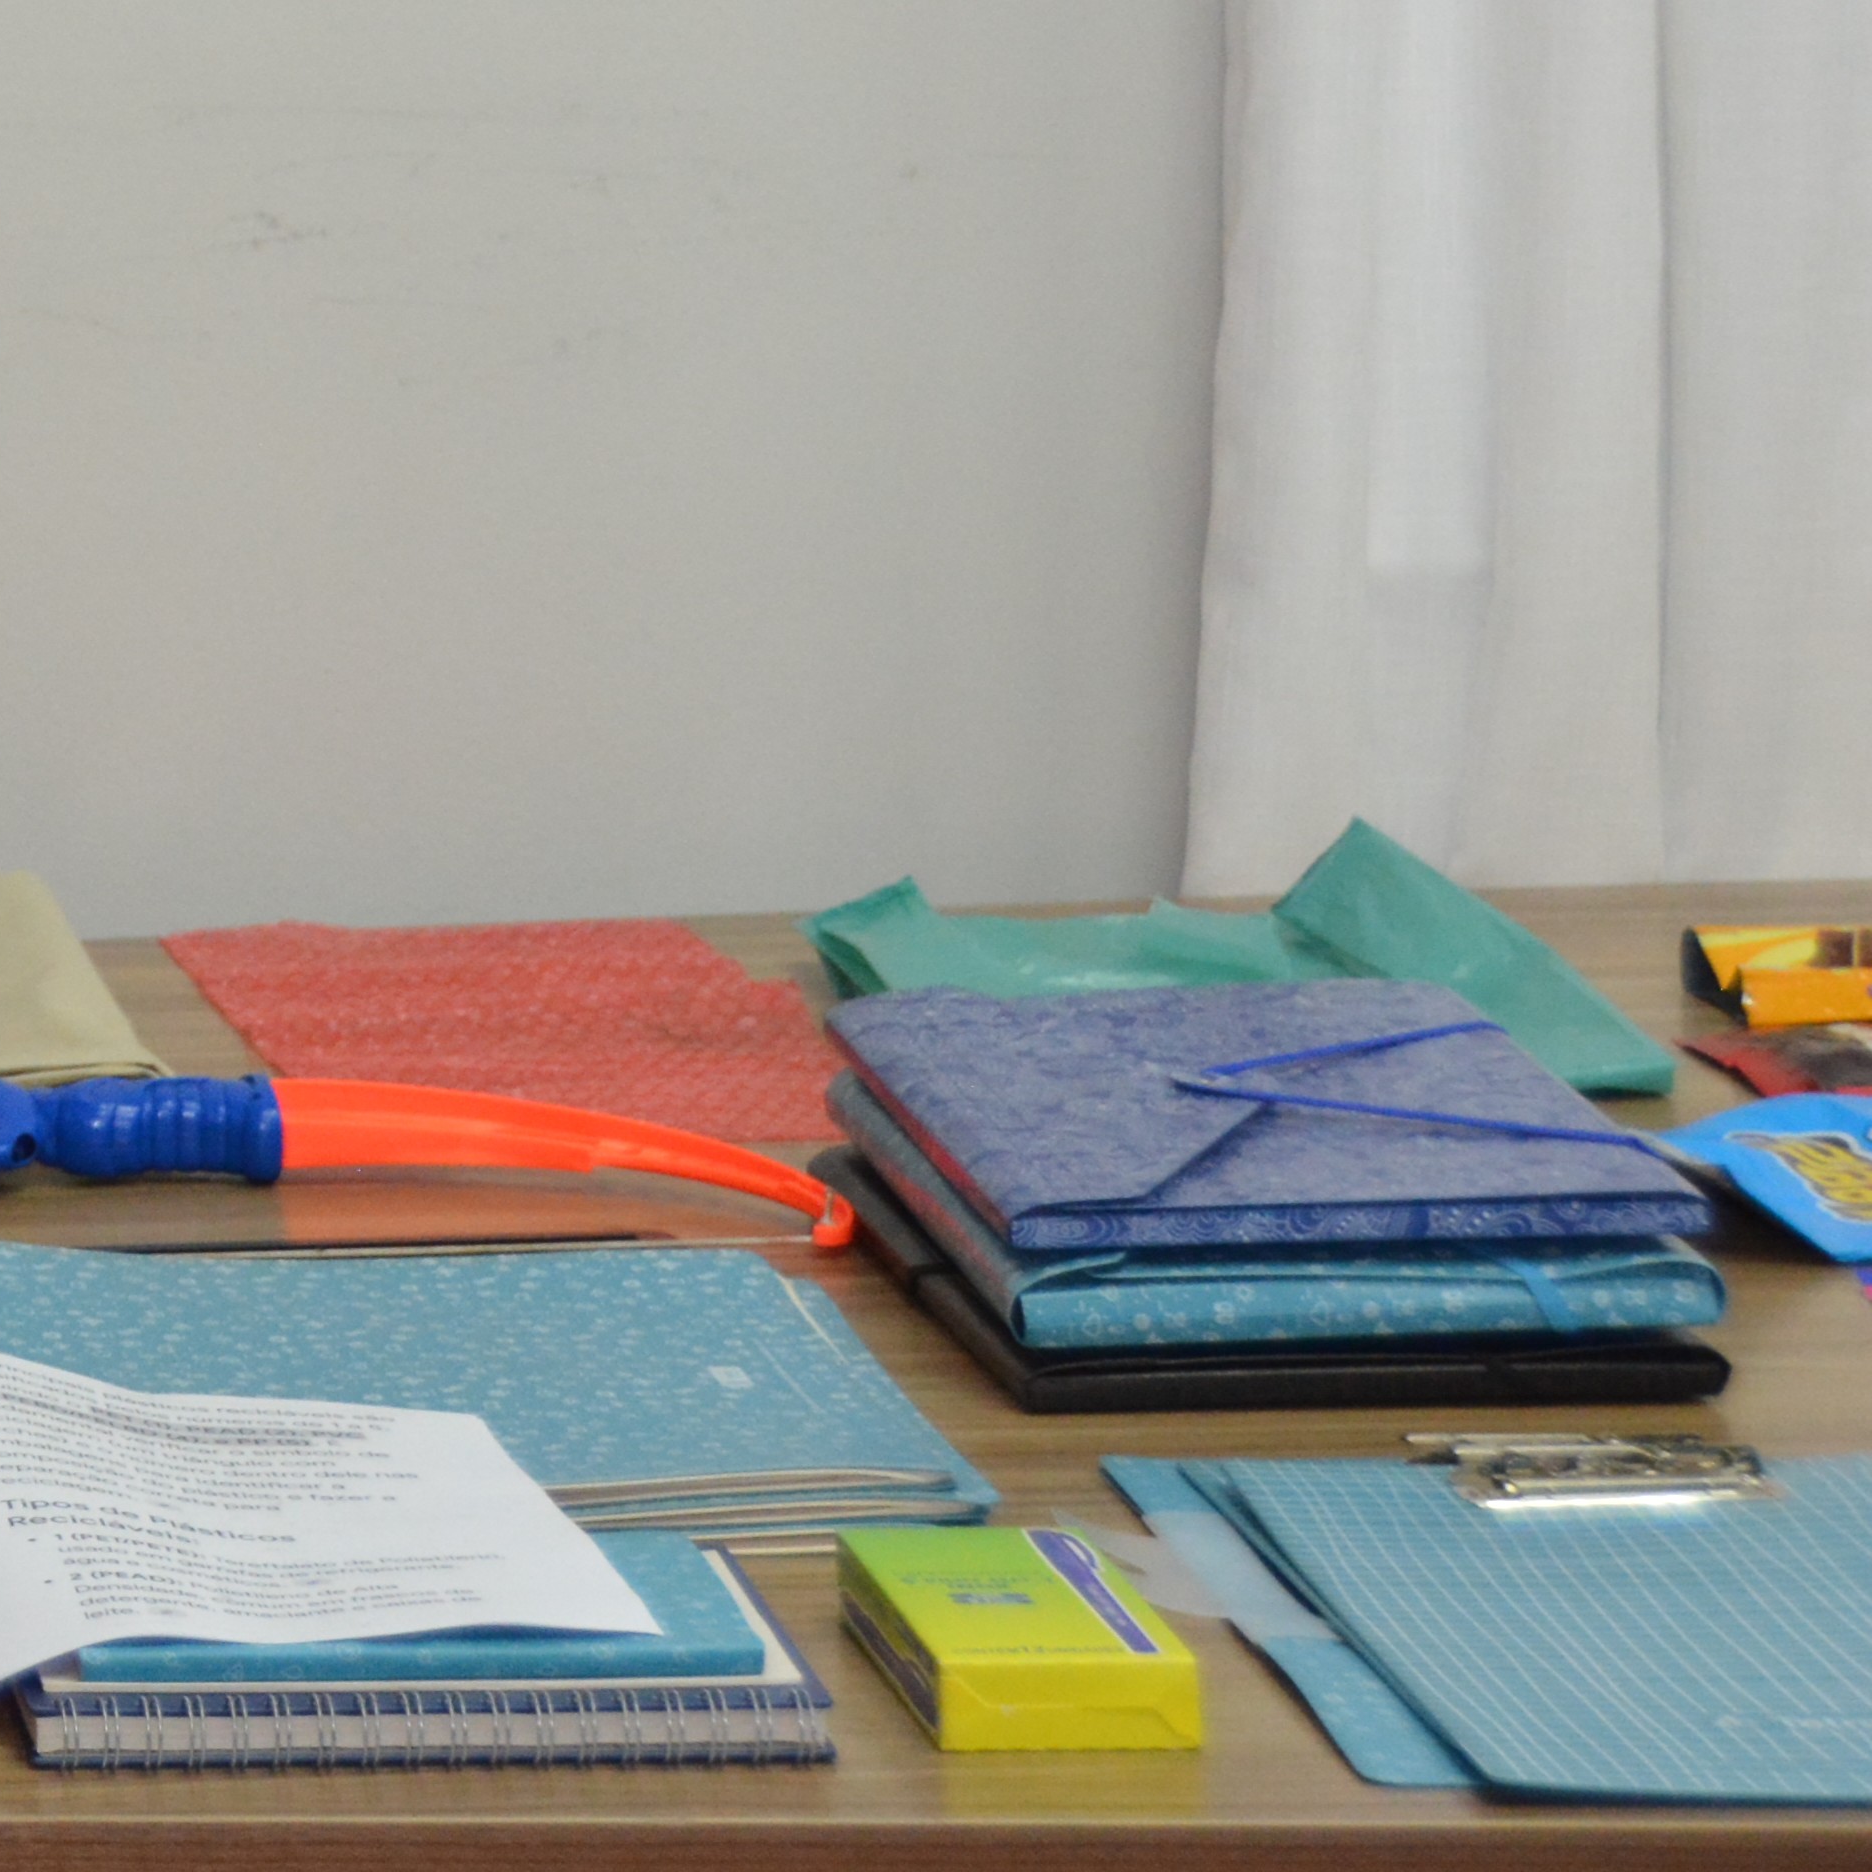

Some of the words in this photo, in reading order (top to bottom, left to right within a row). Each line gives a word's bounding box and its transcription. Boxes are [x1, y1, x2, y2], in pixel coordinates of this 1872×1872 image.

[0, 1498, 89, 1510] Tipos
[99, 1507, 139, 1519] de
[149, 1514, 296, 1542] Plásticos
